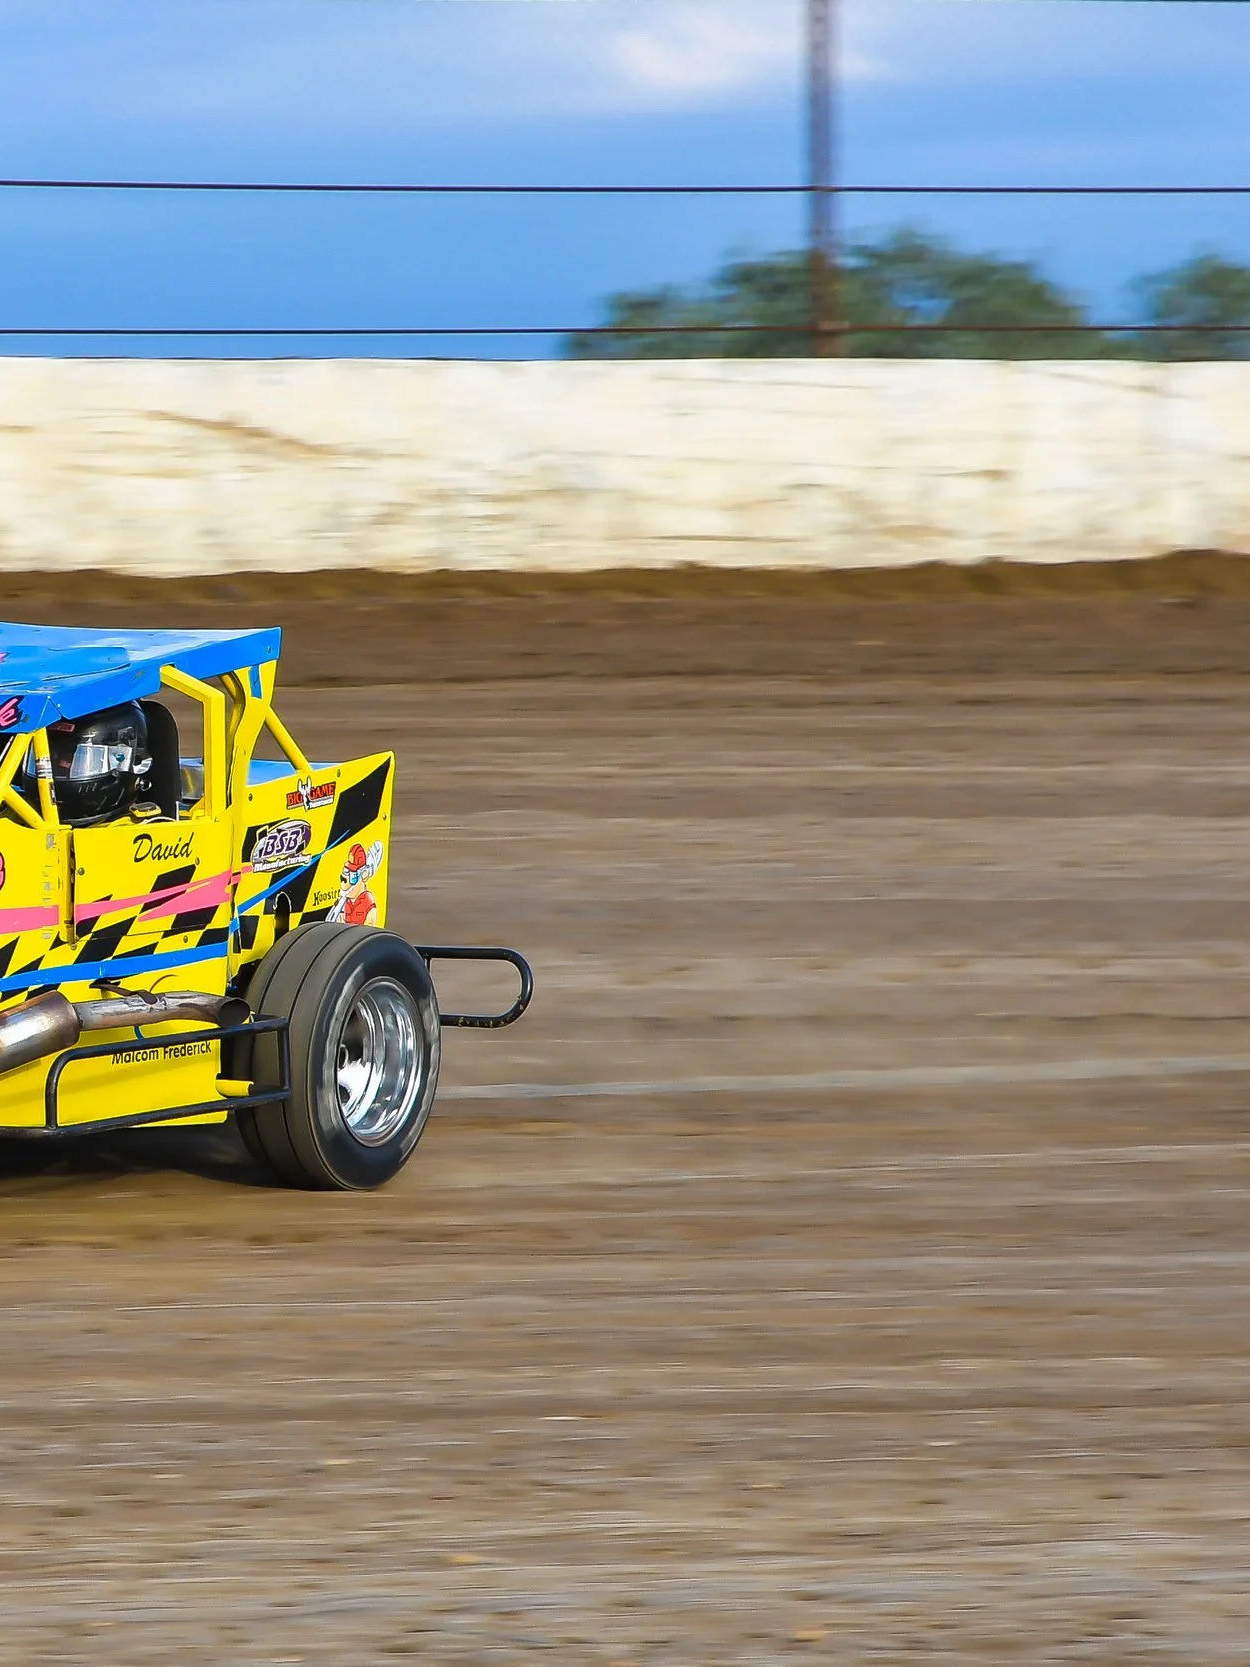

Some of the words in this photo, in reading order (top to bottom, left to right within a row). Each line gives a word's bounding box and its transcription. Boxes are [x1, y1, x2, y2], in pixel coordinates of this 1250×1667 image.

[287, 792, 304, 807] BIG
[310, 782, 335, 801] GAME
[133, 832, 194, 863] David
[263, 829, 301, 857] BSB
[111, 1049, 159, 1065] Malcom
[163, 1042, 212, 1060] Frederick
